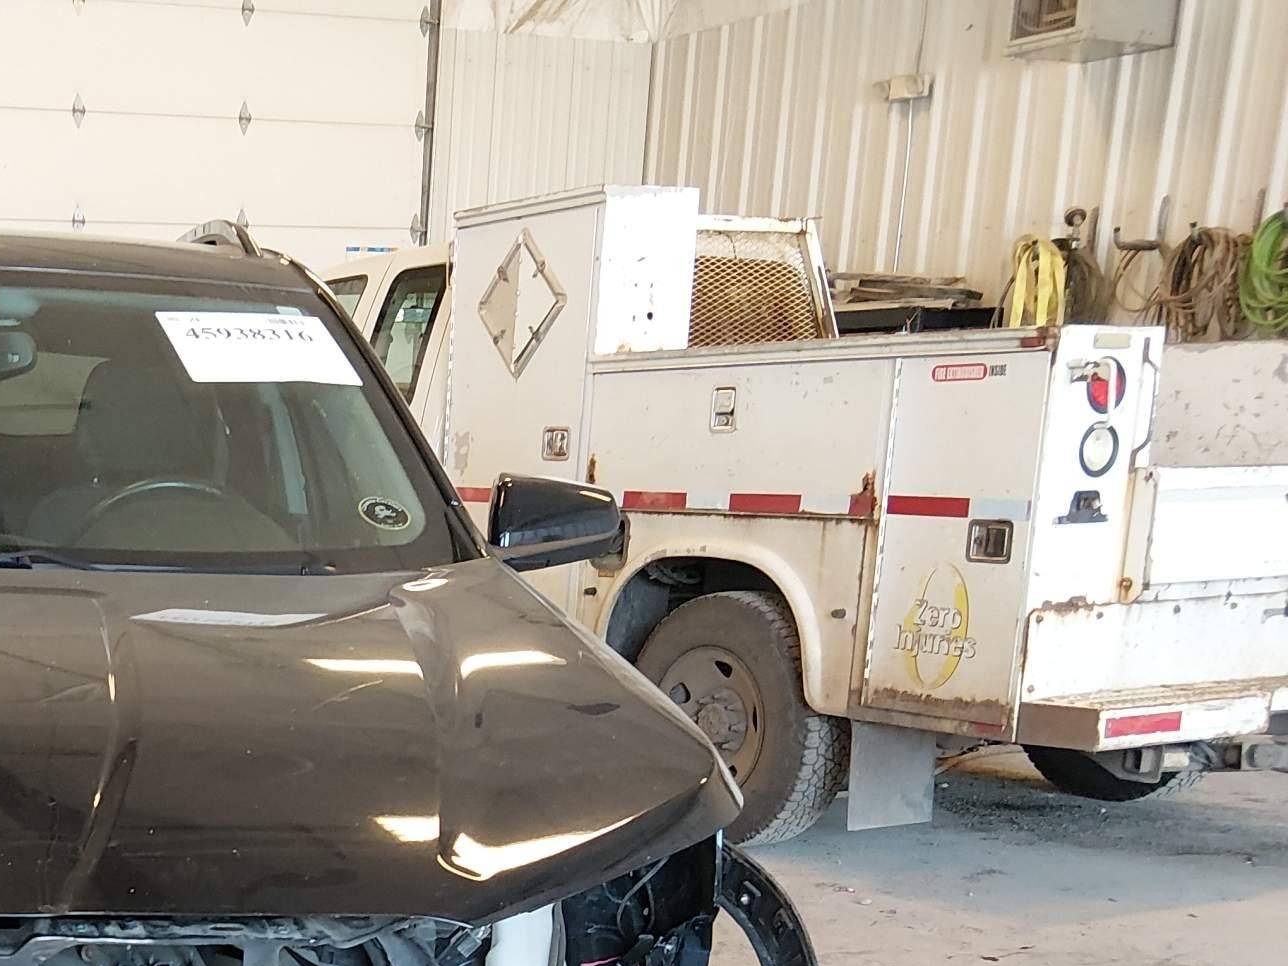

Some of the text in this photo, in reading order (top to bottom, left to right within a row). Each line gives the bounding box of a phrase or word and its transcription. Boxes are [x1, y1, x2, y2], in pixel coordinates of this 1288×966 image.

[185, 327, 313, 342] 45938316
[913, 599, 963, 630] Zero
[894, 623, 977, 659] Injuries
